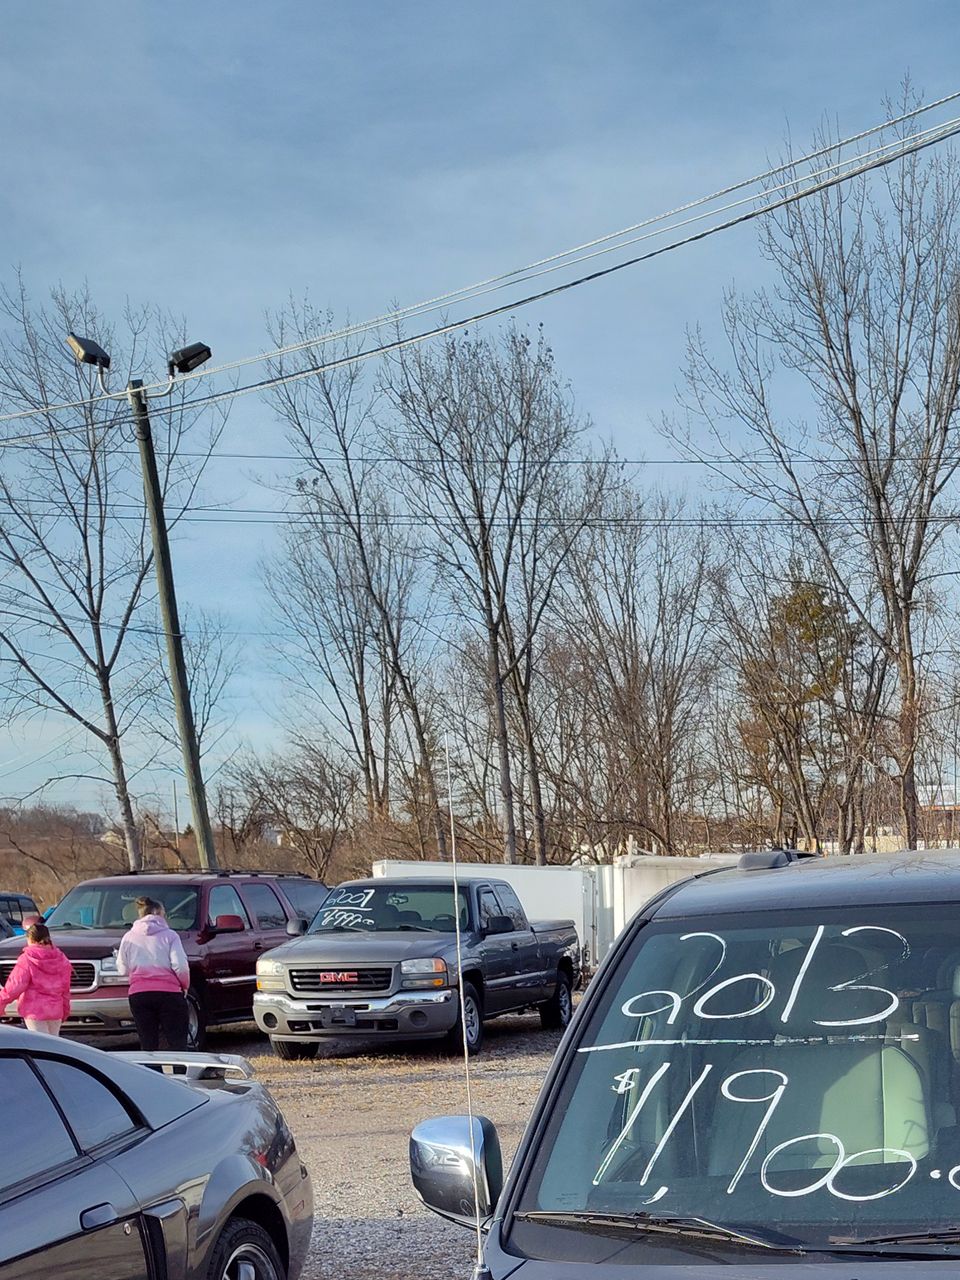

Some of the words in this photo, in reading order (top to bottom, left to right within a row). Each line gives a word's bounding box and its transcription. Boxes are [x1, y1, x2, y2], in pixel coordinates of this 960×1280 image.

[326, 888, 376, 908] 2007
[320, 971, 359, 982] GMC
[620, 924, 912, 1026] 2013
